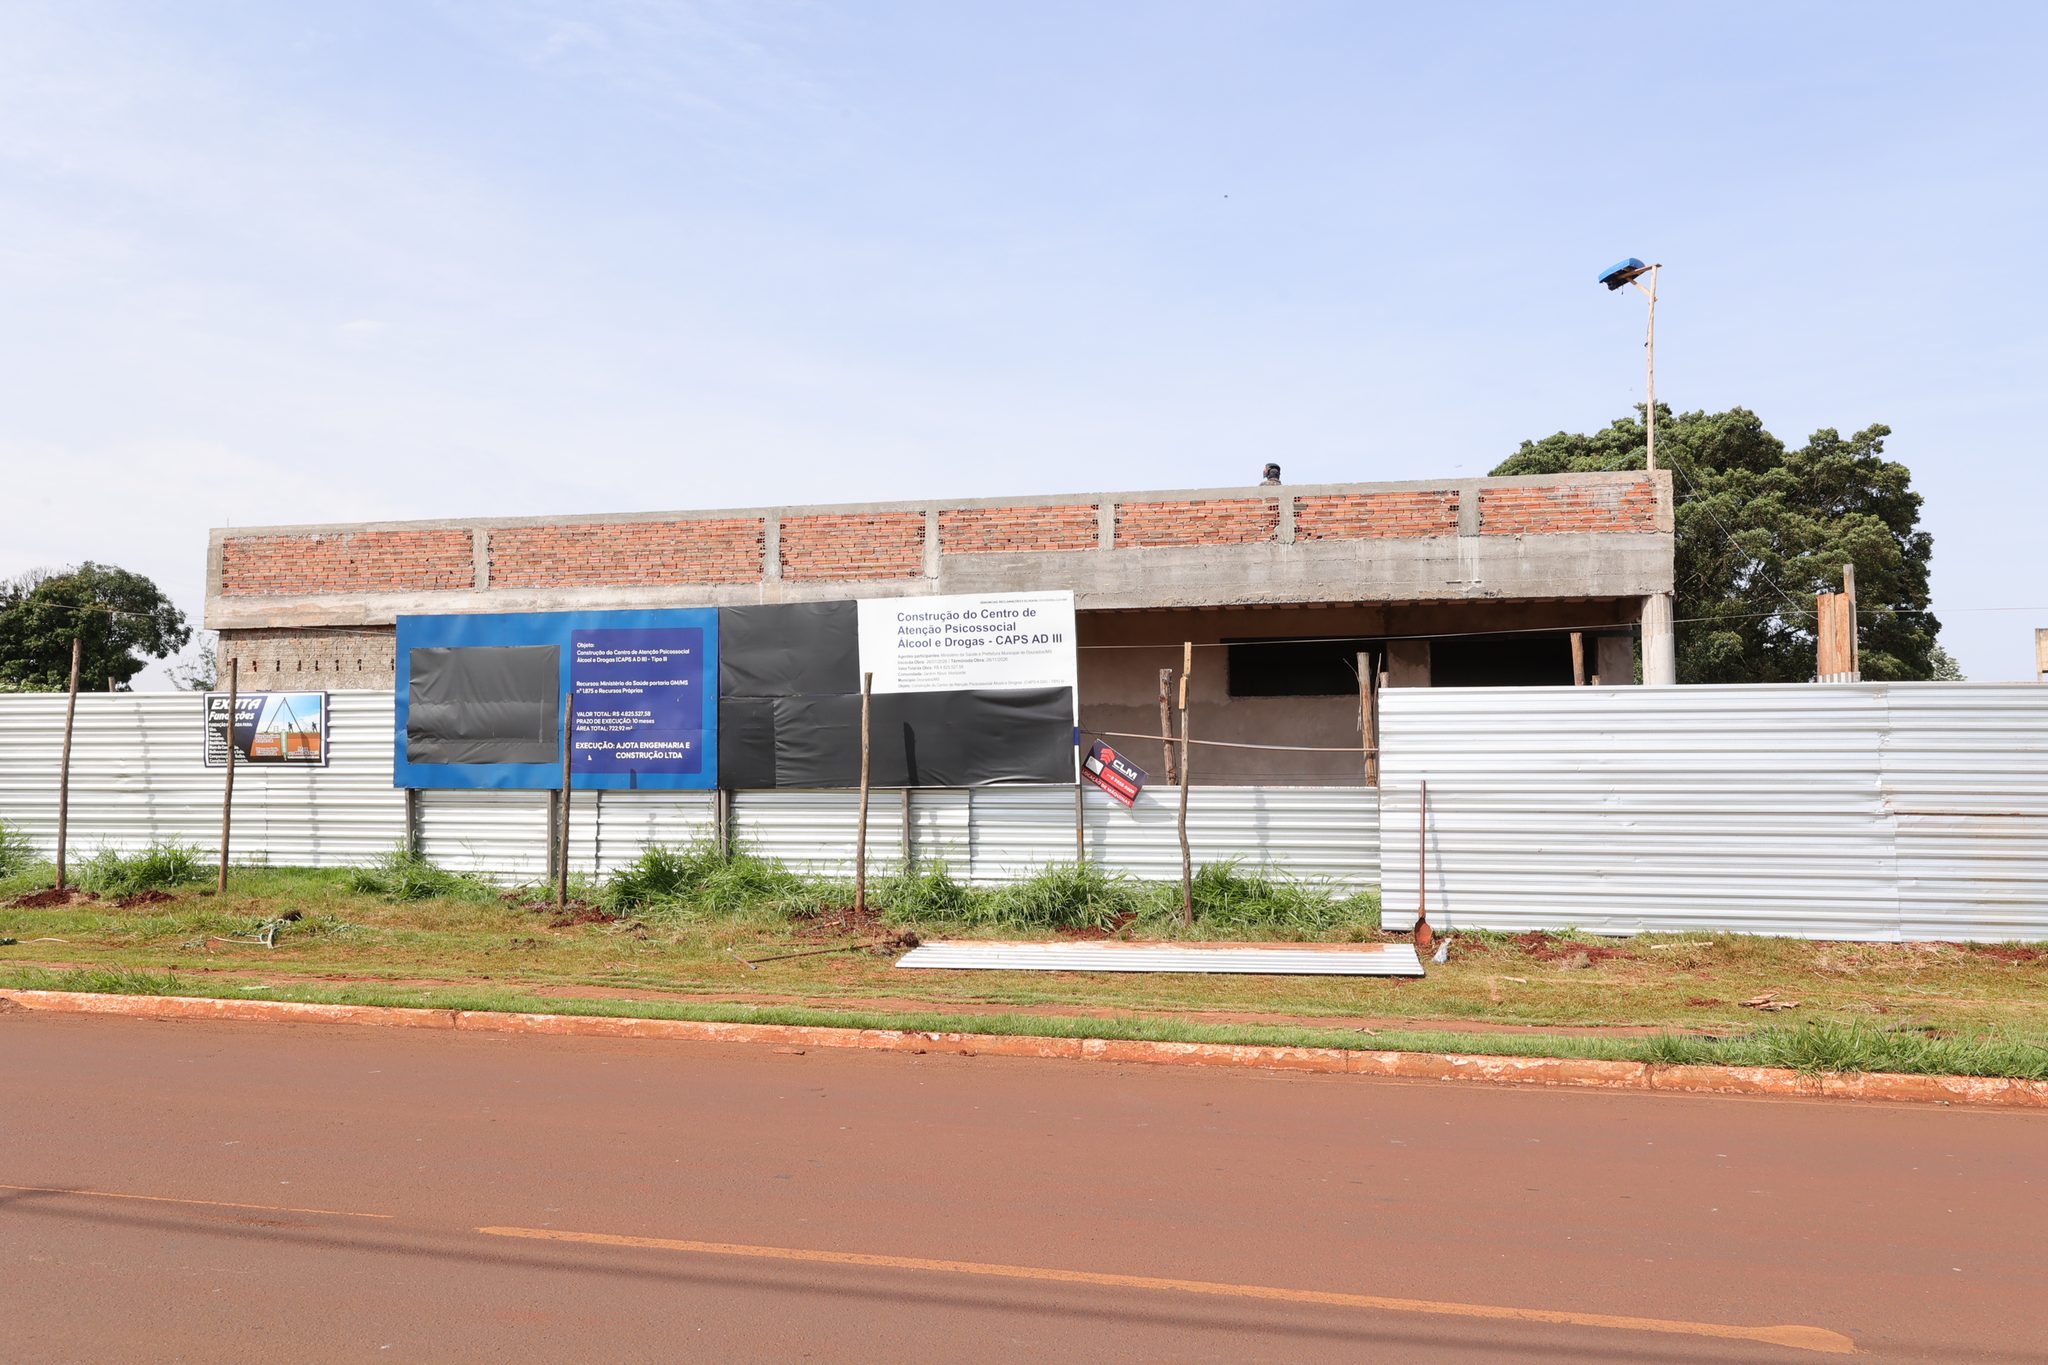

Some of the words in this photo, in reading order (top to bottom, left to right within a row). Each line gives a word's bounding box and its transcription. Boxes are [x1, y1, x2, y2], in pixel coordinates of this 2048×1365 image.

[897, 610, 960, 622] Construção
[963, 610, 977, 620] do
[981, 609, 1019, 619] Centro
[1022, 608, 1036, 617] de
[897, 624, 941, 637] Atenção
[945, 622, 1016, 633] Psicossocial
[898, 636, 932, 648] Álcool
[945, 637, 984, 648] Drogas
[995, 635, 1028, 645] CAPS
[1032, 634, 1049, 644] AD
[1052, 633, 1062, 643] III
[576, 741, 615, 750] EXECUÇÃO:
[616, 750, 664, 760] CONSTRUÇÃO
[1112, 760, 1138, 780] CLM
